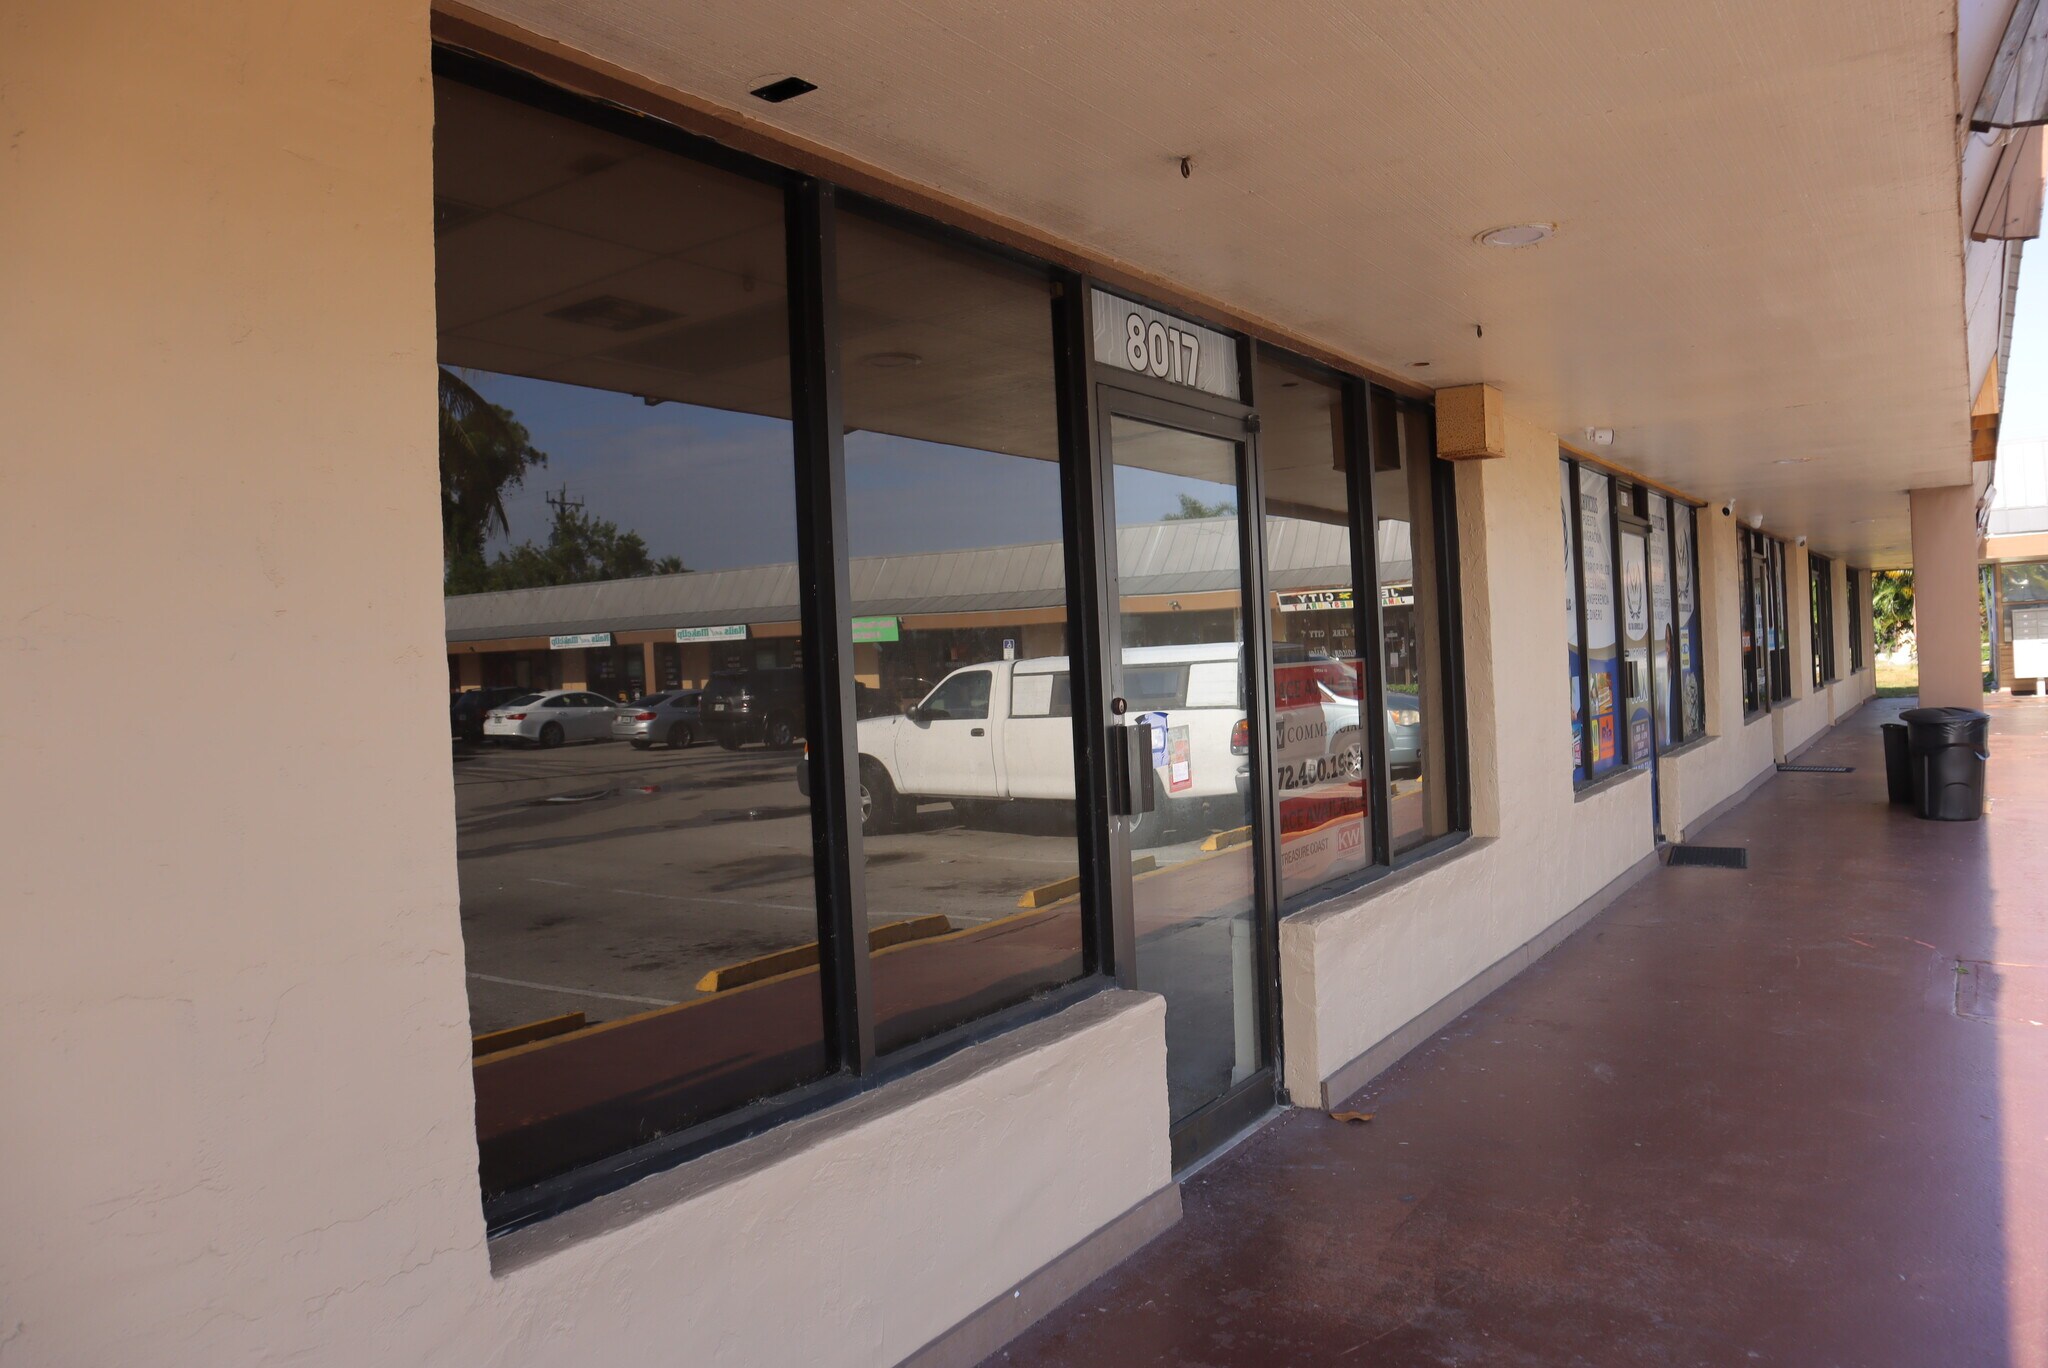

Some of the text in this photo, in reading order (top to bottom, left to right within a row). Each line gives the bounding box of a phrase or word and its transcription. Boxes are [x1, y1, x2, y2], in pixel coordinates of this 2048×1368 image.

[1126, 313, 1199, 386] 8017
[1281, 844, 1310, 866] TREASURE
[1310, 838, 1329, 856] COAST
[1339, 827, 1360, 850] KW
